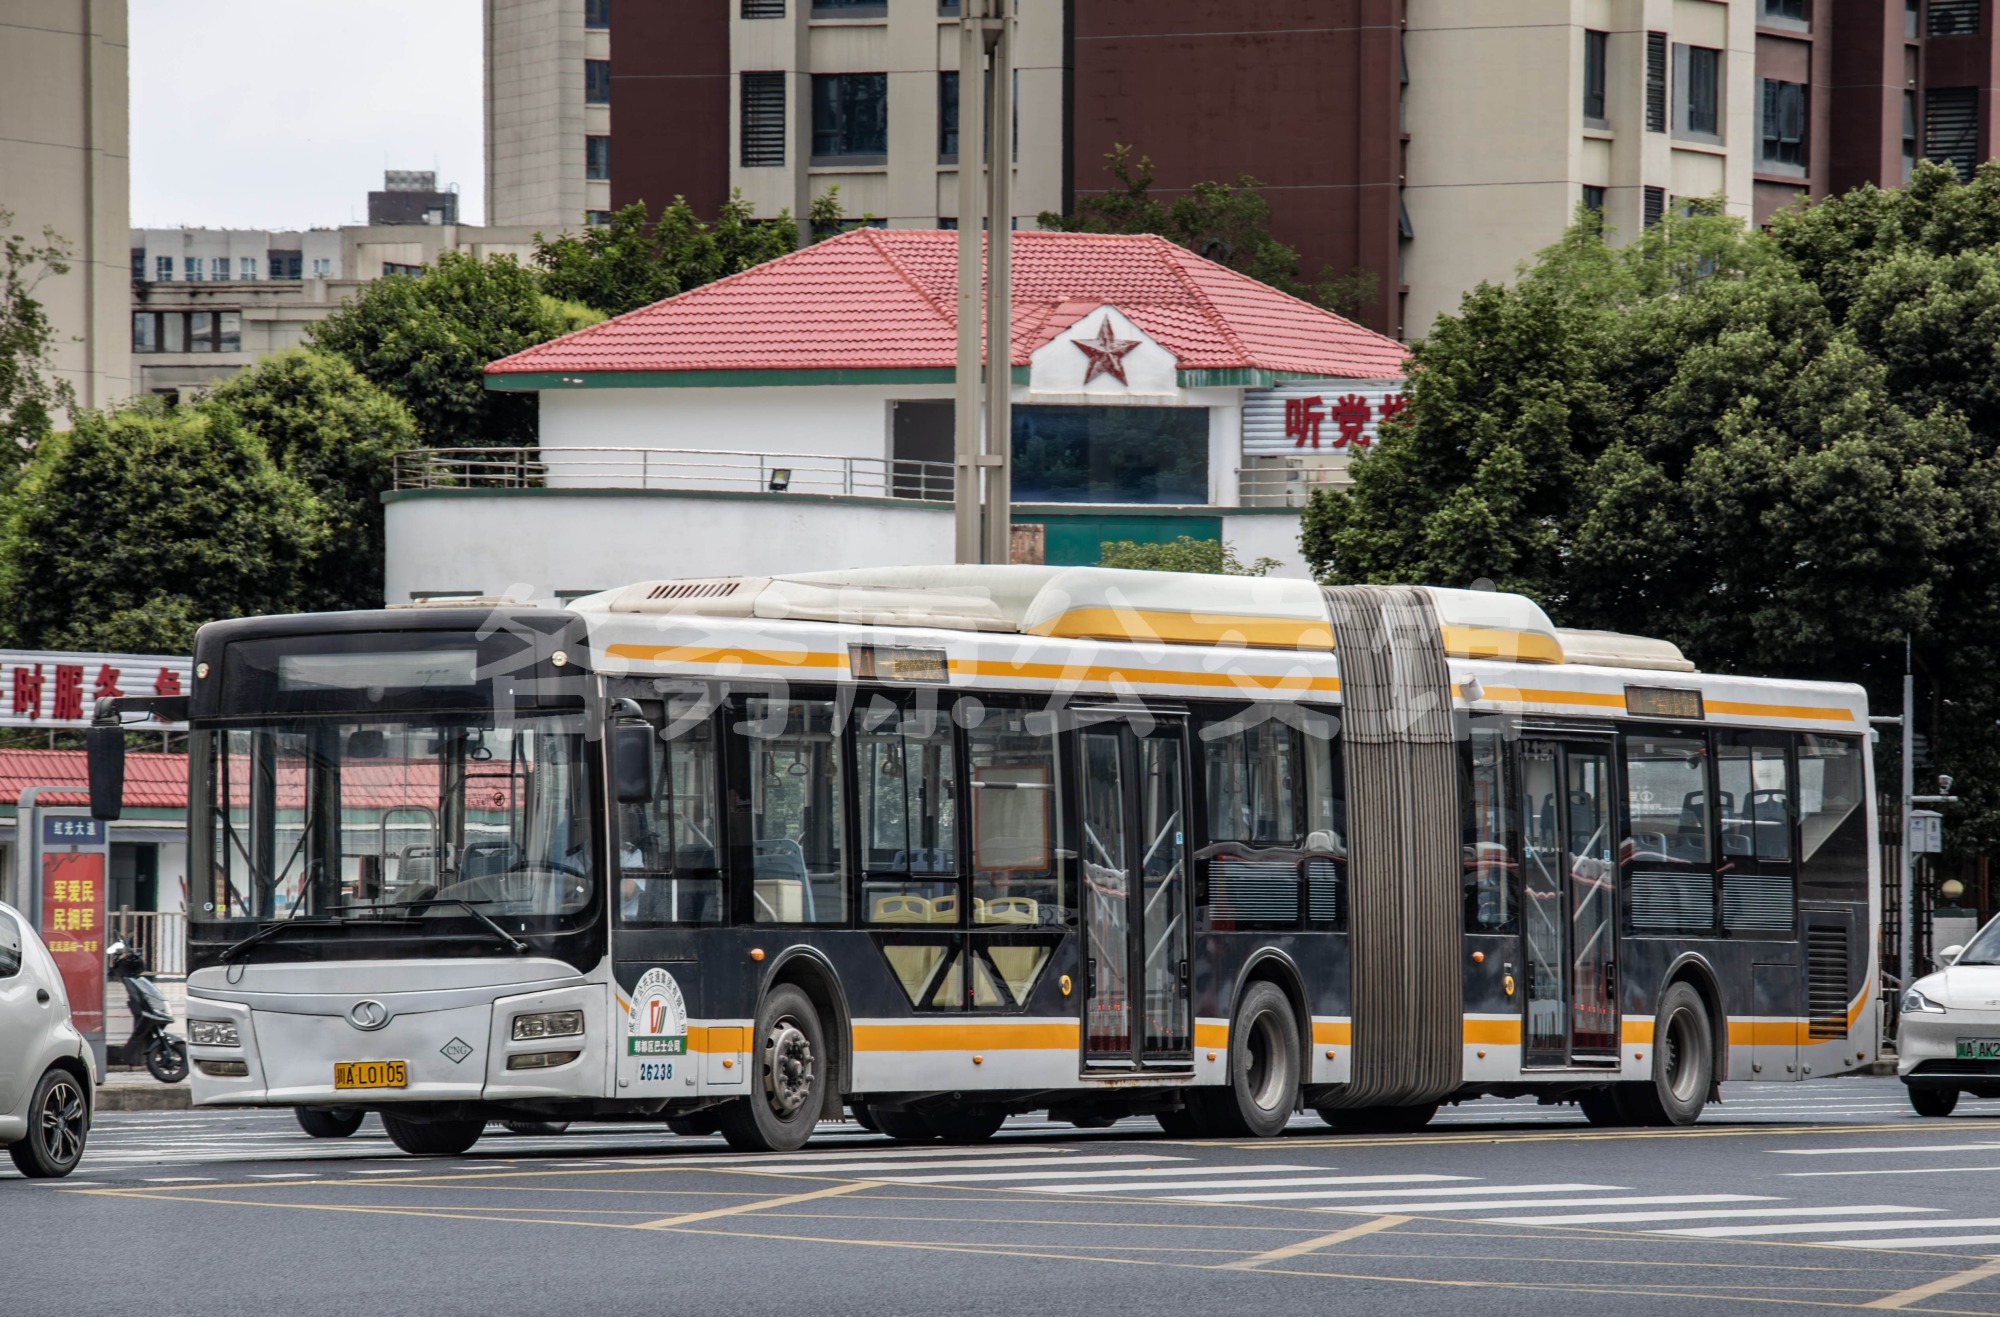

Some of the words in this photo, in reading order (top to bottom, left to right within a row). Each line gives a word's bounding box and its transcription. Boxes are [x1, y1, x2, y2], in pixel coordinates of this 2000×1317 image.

[53, 880, 94, 902] 军爱民
[53, 907, 94, 930] 民拥军
[446, 1046, 468, 1055] CNG
[640, 1063, 673, 1081] 26238
